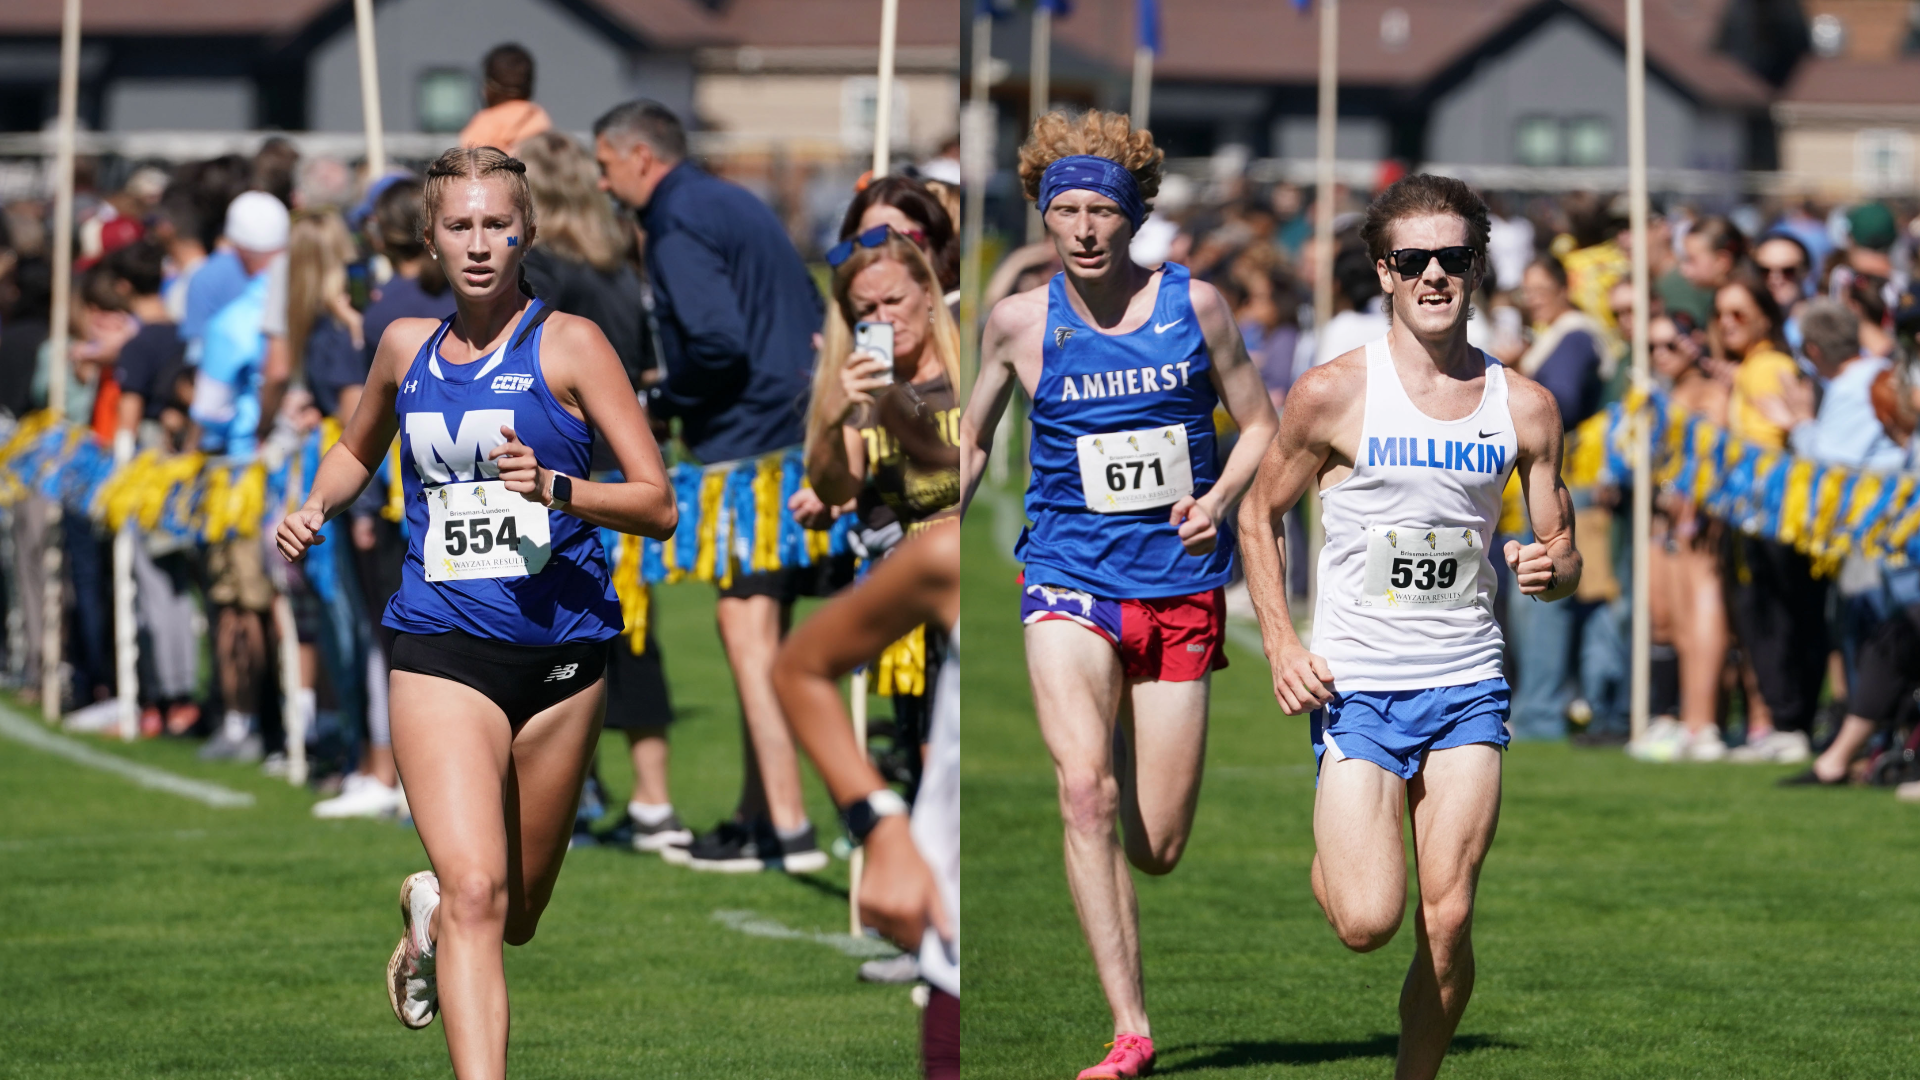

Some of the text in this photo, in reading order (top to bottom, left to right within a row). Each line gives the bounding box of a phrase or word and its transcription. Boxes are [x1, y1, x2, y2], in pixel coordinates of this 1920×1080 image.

[490, 375, 535, 392] CCIW
[1061, 361, 1191, 402] AMHERST
[405, 409, 515, 484] M
[1368, 436, 1505, 475] MILLIKIN
[1105, 457, 1165, 492] 671
[1115, 494, 1147, 502] WAYZATA
[1148, 488, 1178, 498] RESULTS
[449, 507, 510, 517] Brissman-Lundeen
[444, 515, 521, 556] 554
[453, 560, 491, 569] WAYZATA
[493, 556, 529, 566] RESULTS
[1390, 557, 1458, 590] 539
[1395, 593, 1431, 602] WAYZATA
[1432, 592, 1461, 601] RESULTS
